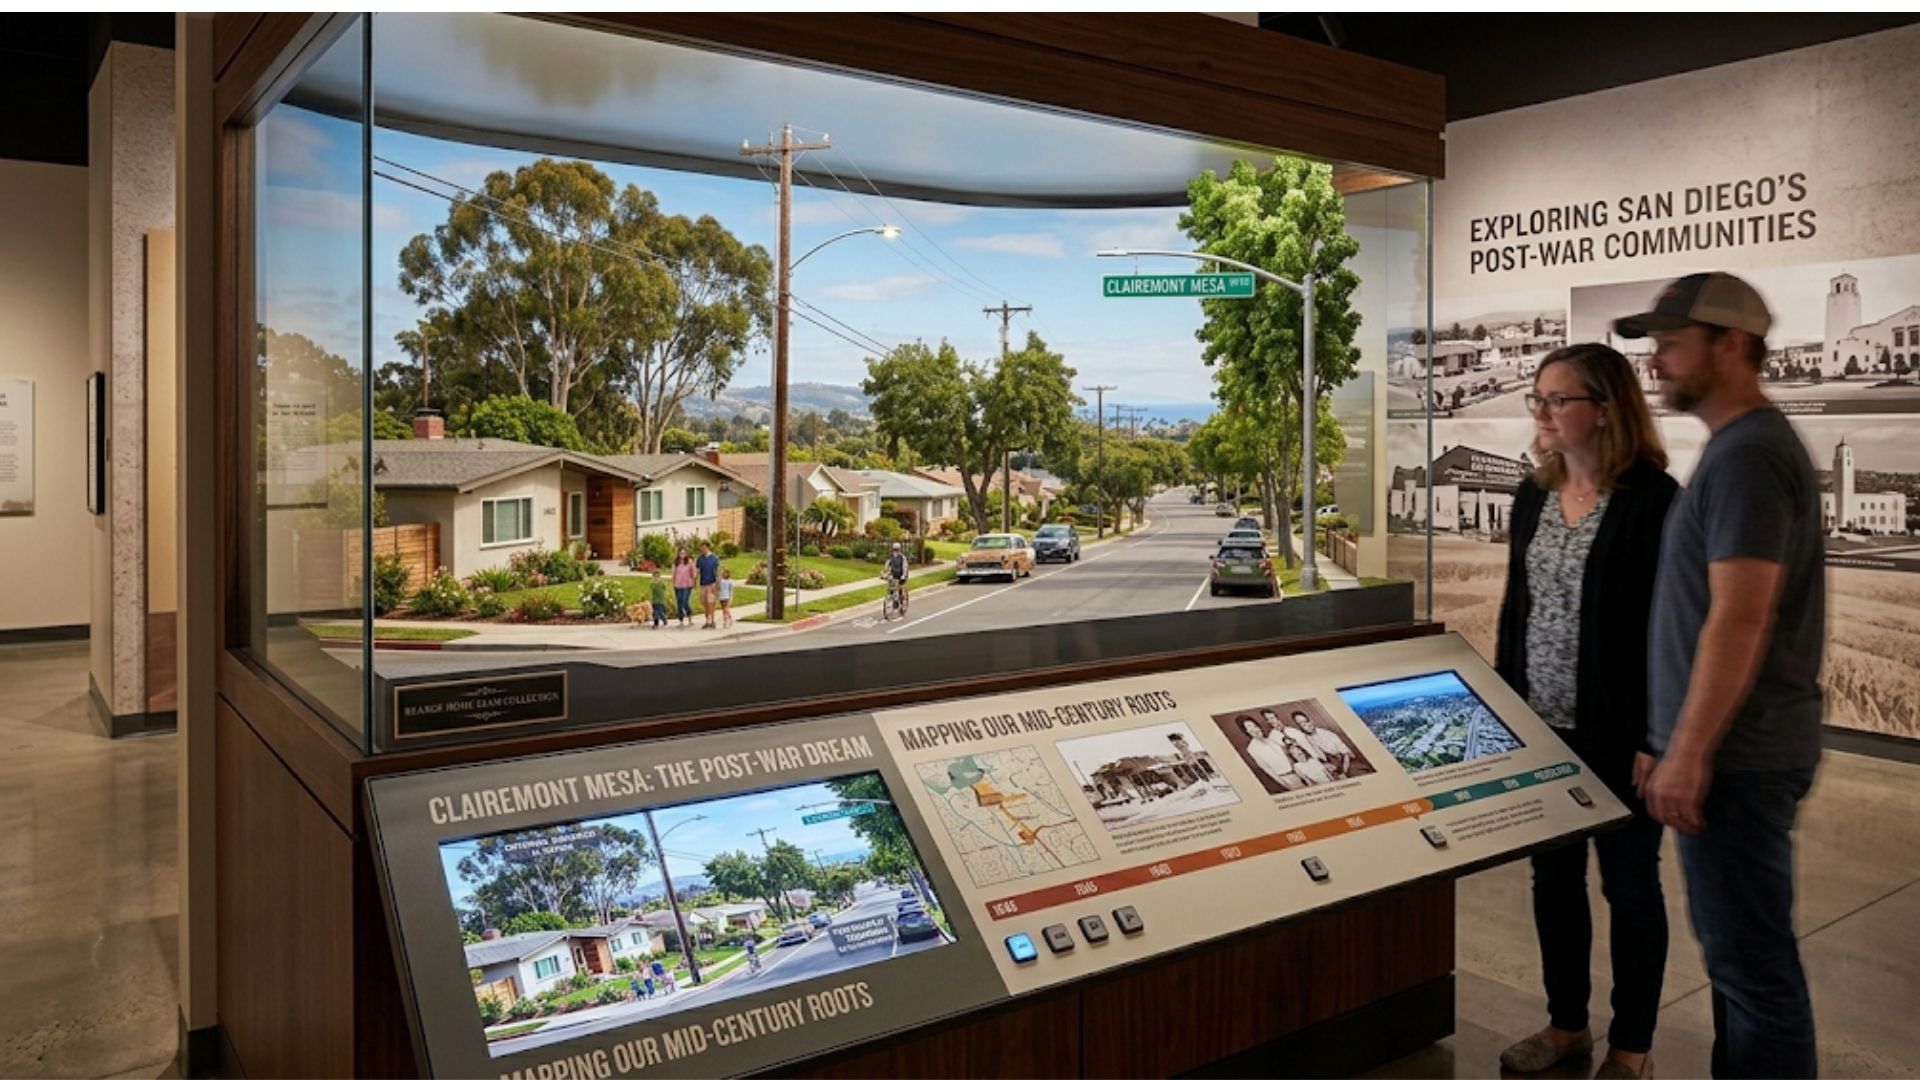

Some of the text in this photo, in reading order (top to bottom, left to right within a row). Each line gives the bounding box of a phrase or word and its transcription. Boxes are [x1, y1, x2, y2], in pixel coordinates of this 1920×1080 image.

[1471, 172, 1807, 242] EXPLORING SAN DIEGO'S
[1471, 209, 1817, 274] POST-WAR COMMUNITIES
[1106, 278, 1186, 294] CLAIREMONT
[1190, 277, 1226, 293] MESA
[503, 692, 560, 706] COLLECTION
[898, 689, 1178, 751] MAPPING OUR MID-CENTURY ROOTS
[429, 735, 874, 825] CLAIREMONT MESA: THE POST-WAR DREAM
[612, 1037, 663, 1074] OUR
[661, 997, 807, 1061] MID-CENTURY
[809, 981, 874, 1022] ROOTS
